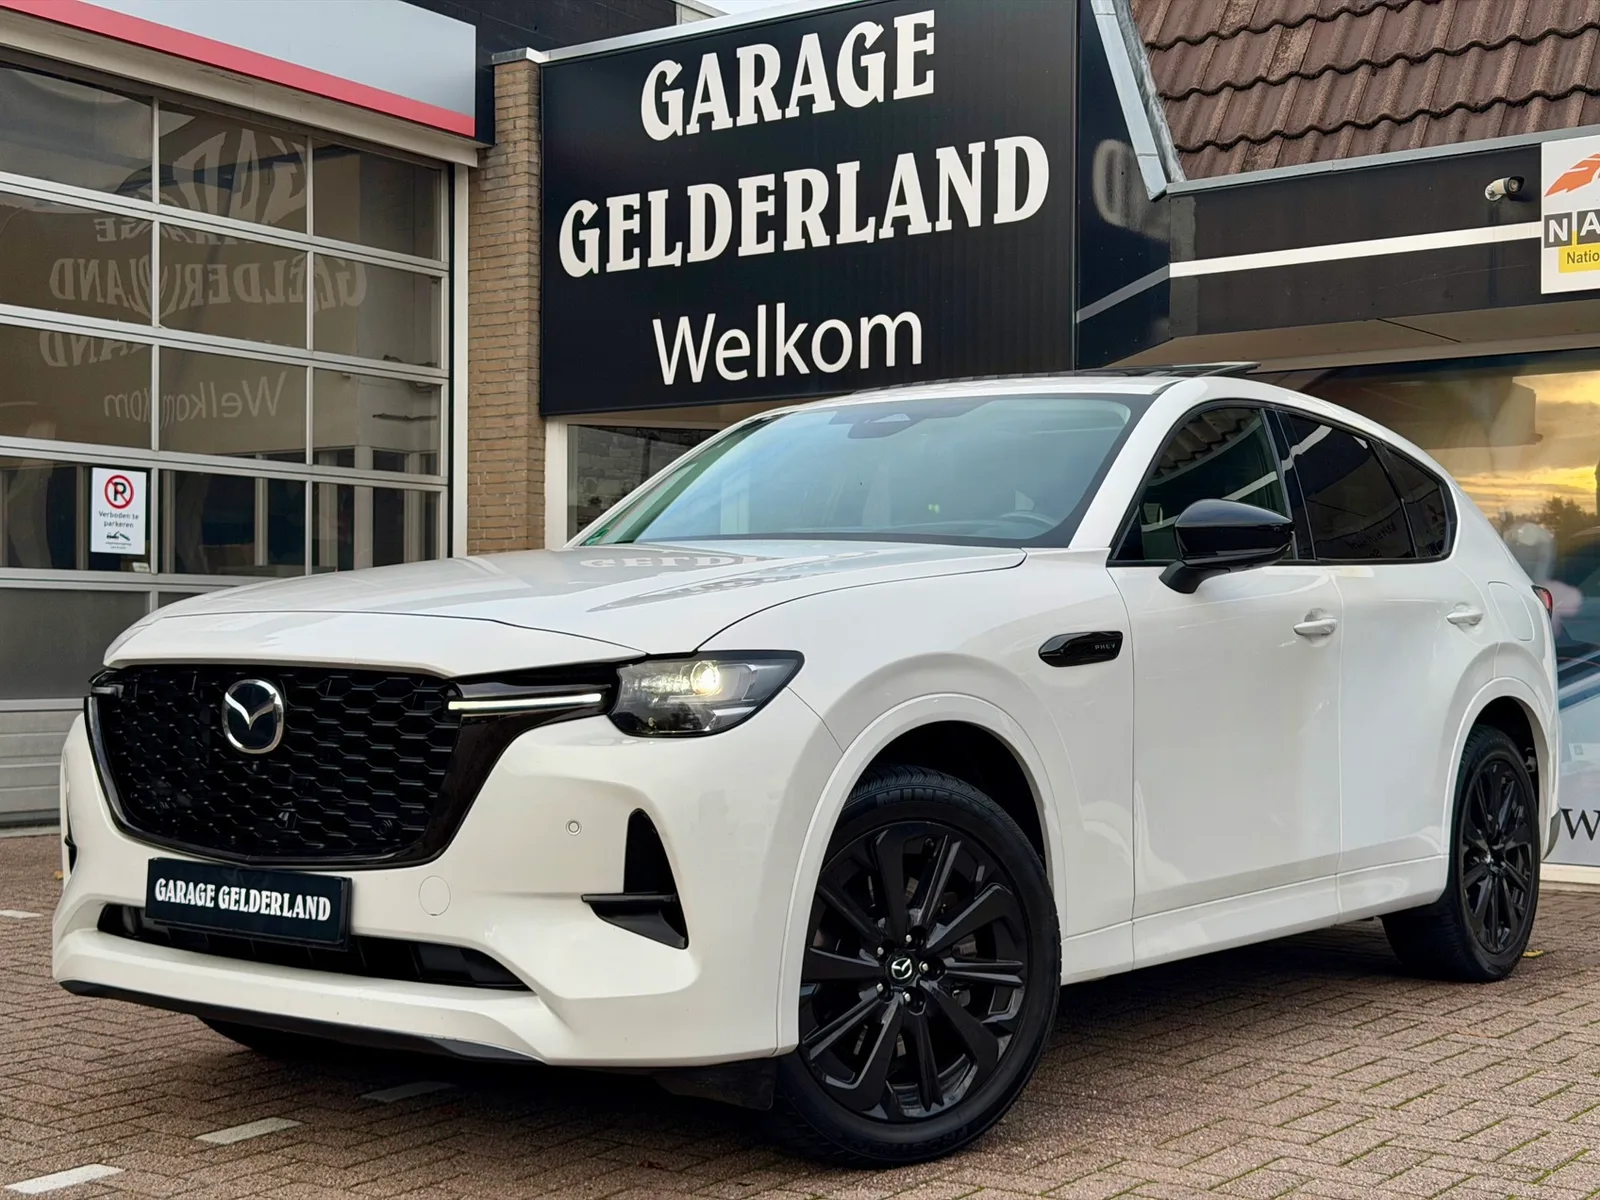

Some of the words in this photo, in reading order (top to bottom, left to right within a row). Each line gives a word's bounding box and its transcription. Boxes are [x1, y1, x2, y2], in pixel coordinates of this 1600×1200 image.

[641, 10, 935, 141] GARAGE
[559, 135, 1050, 278] GELDERLAND
[652, 302, 923, 386] Welkom
[99, 511, 131, 519] Verboden
[154, 878, 216, 908] GARAGE
[218, 885, 331, 921] GELDERLAND
